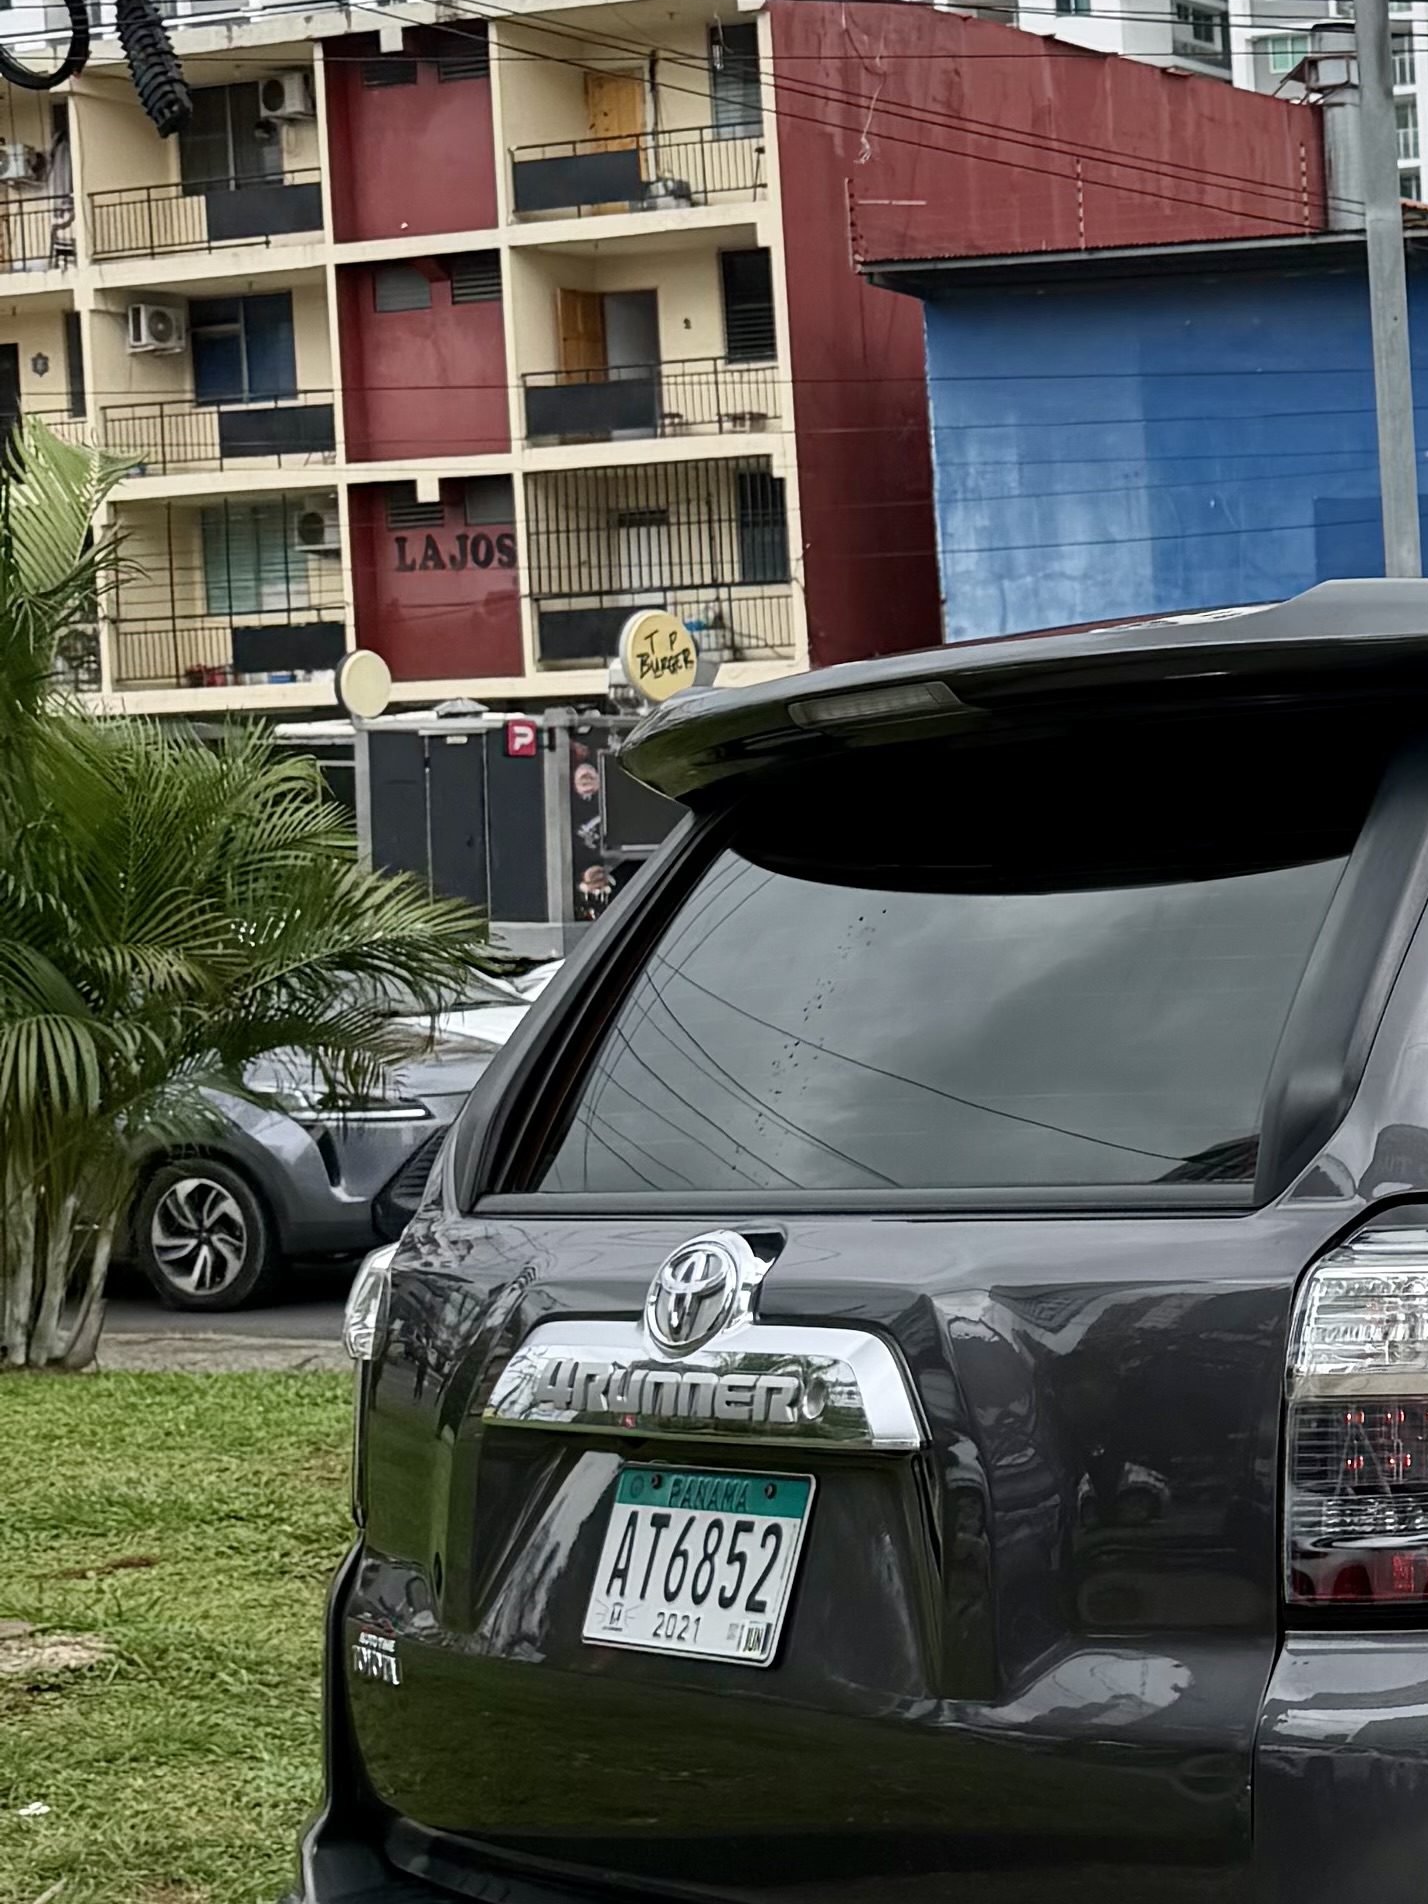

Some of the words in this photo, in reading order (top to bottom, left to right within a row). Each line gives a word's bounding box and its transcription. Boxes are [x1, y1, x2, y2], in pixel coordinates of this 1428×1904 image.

[394, 532, 517, 573] LAJOS
[636, 647, 695, 680] BURGER
[534, 1360, 801, 1424] 4RUNNER
[605, 1509, 784, 1614] AT6852
[652, 1611, 702, 1644] 2021
